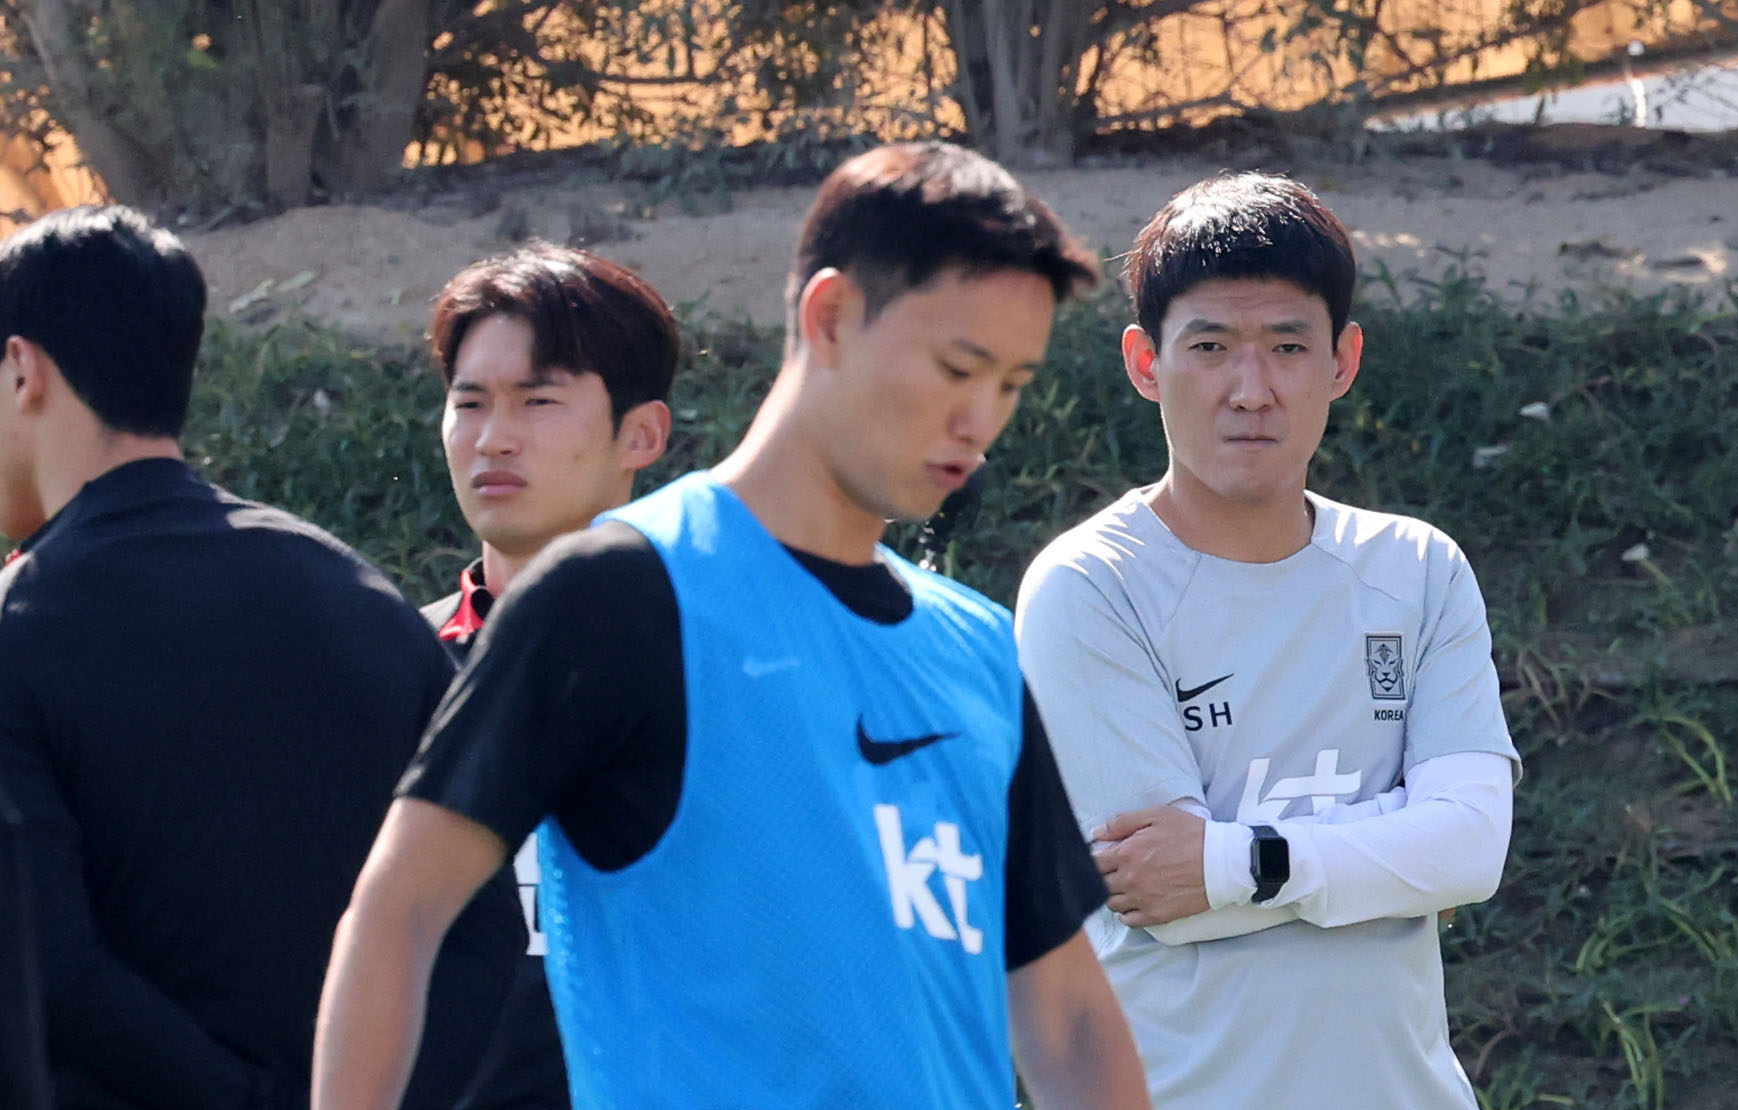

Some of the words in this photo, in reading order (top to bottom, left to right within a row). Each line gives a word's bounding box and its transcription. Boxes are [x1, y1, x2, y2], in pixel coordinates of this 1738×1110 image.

[1182, 701, 1233, 732] SH
[1374, 709, 1404, 721] KOREA
[873, 803, 984, 956] kt
